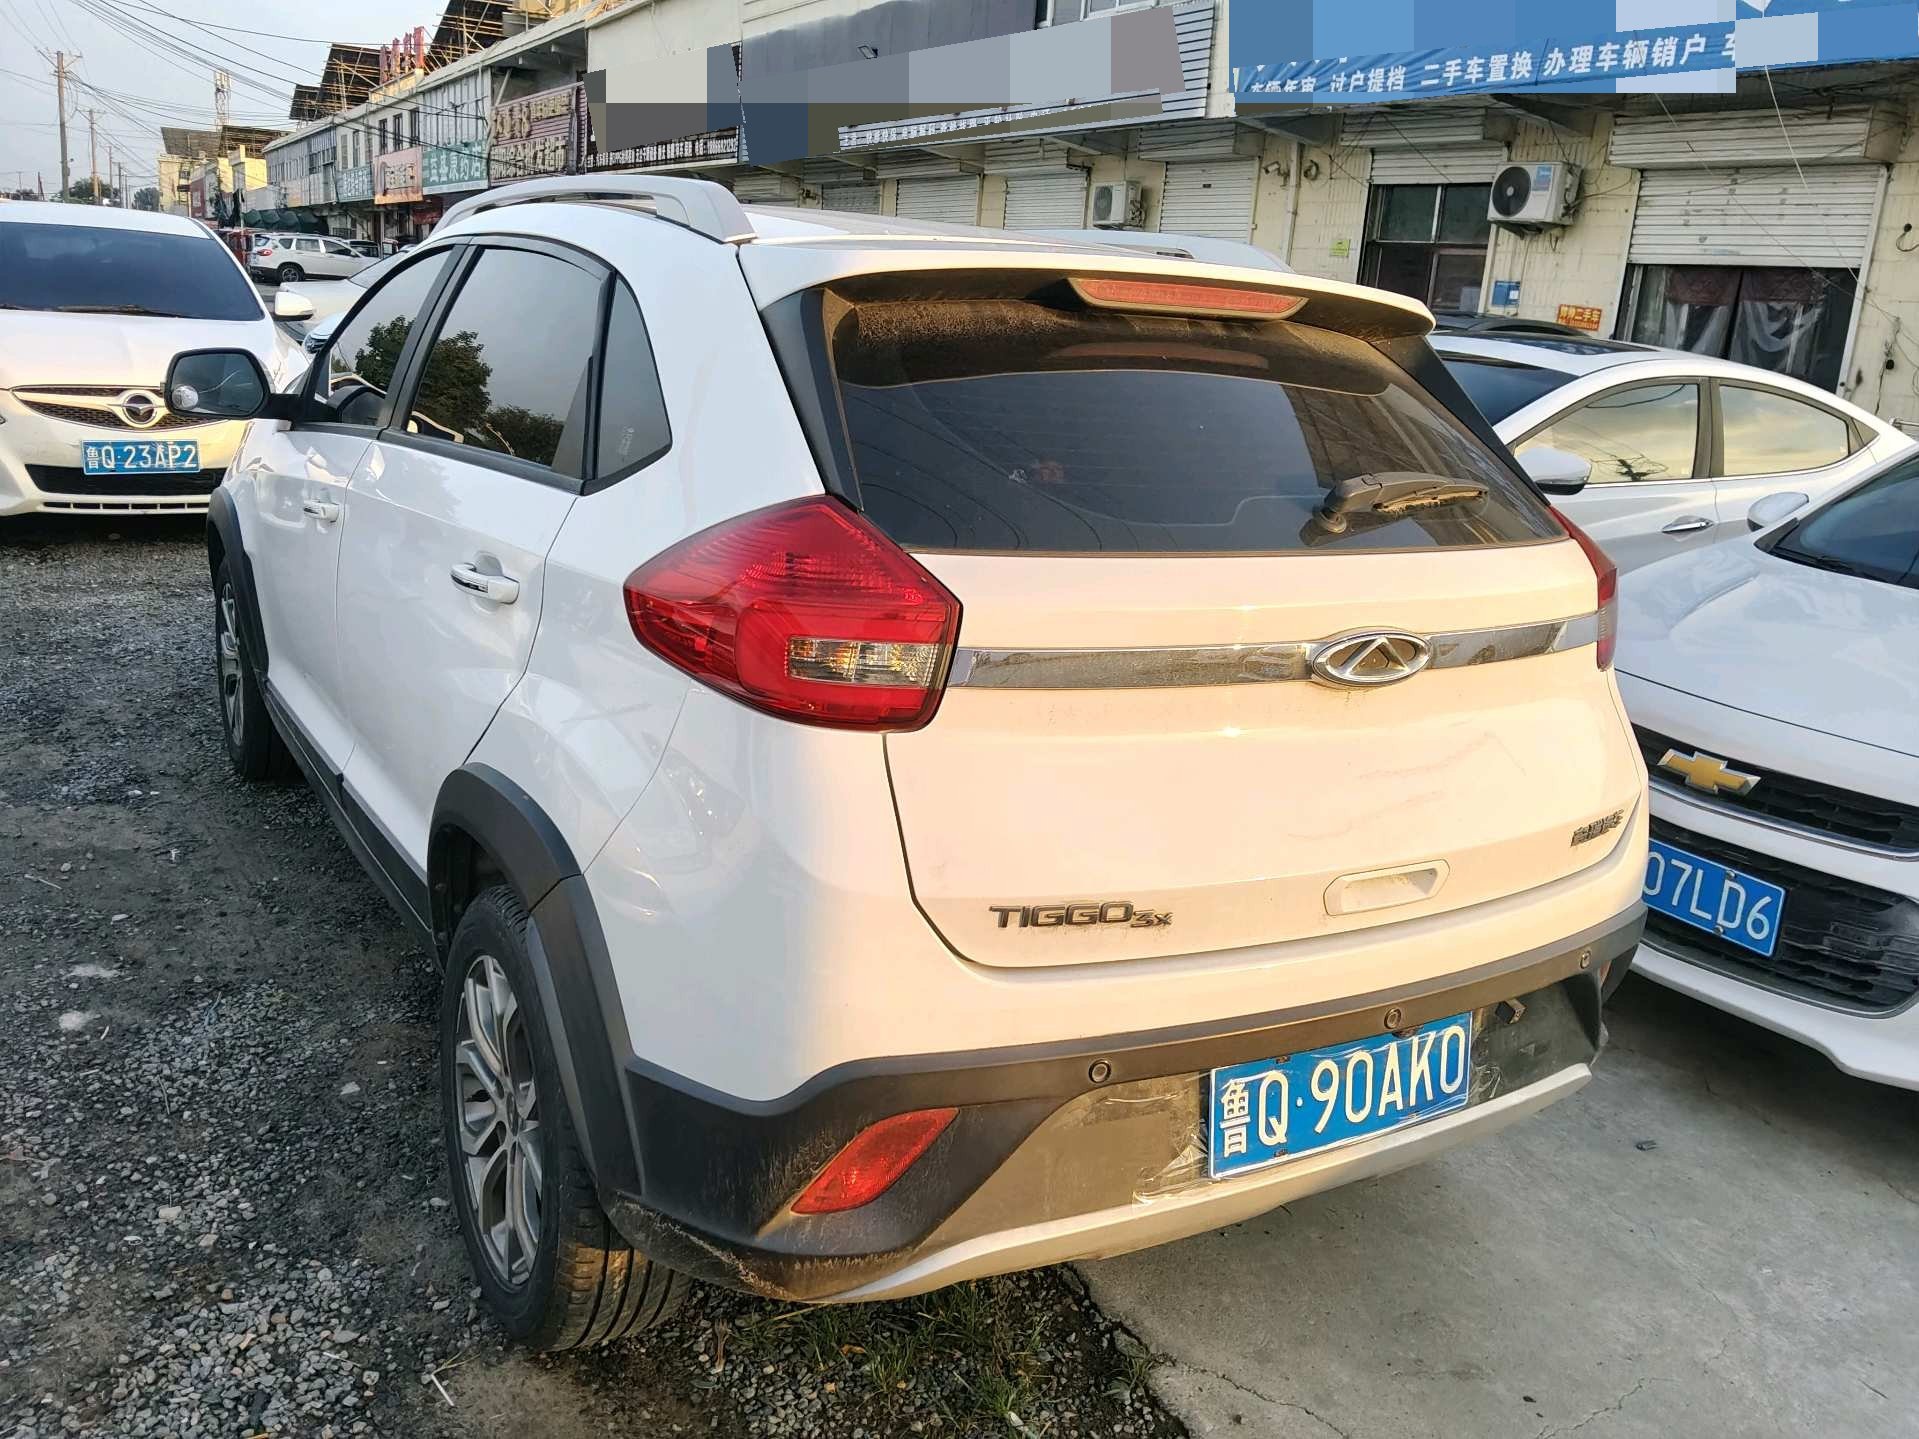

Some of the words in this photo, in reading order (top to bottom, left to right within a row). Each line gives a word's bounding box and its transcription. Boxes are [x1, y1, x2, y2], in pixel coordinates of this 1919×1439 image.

[1420, 51, 1532, 87] 二手车置换
[1543, 33, 1706, 77] 办理车辆销户
[86, 444, 197, 469] 鲁Q·23AP2
[1220, 1025, 1466, 1158] 鲁Q·90AK0
